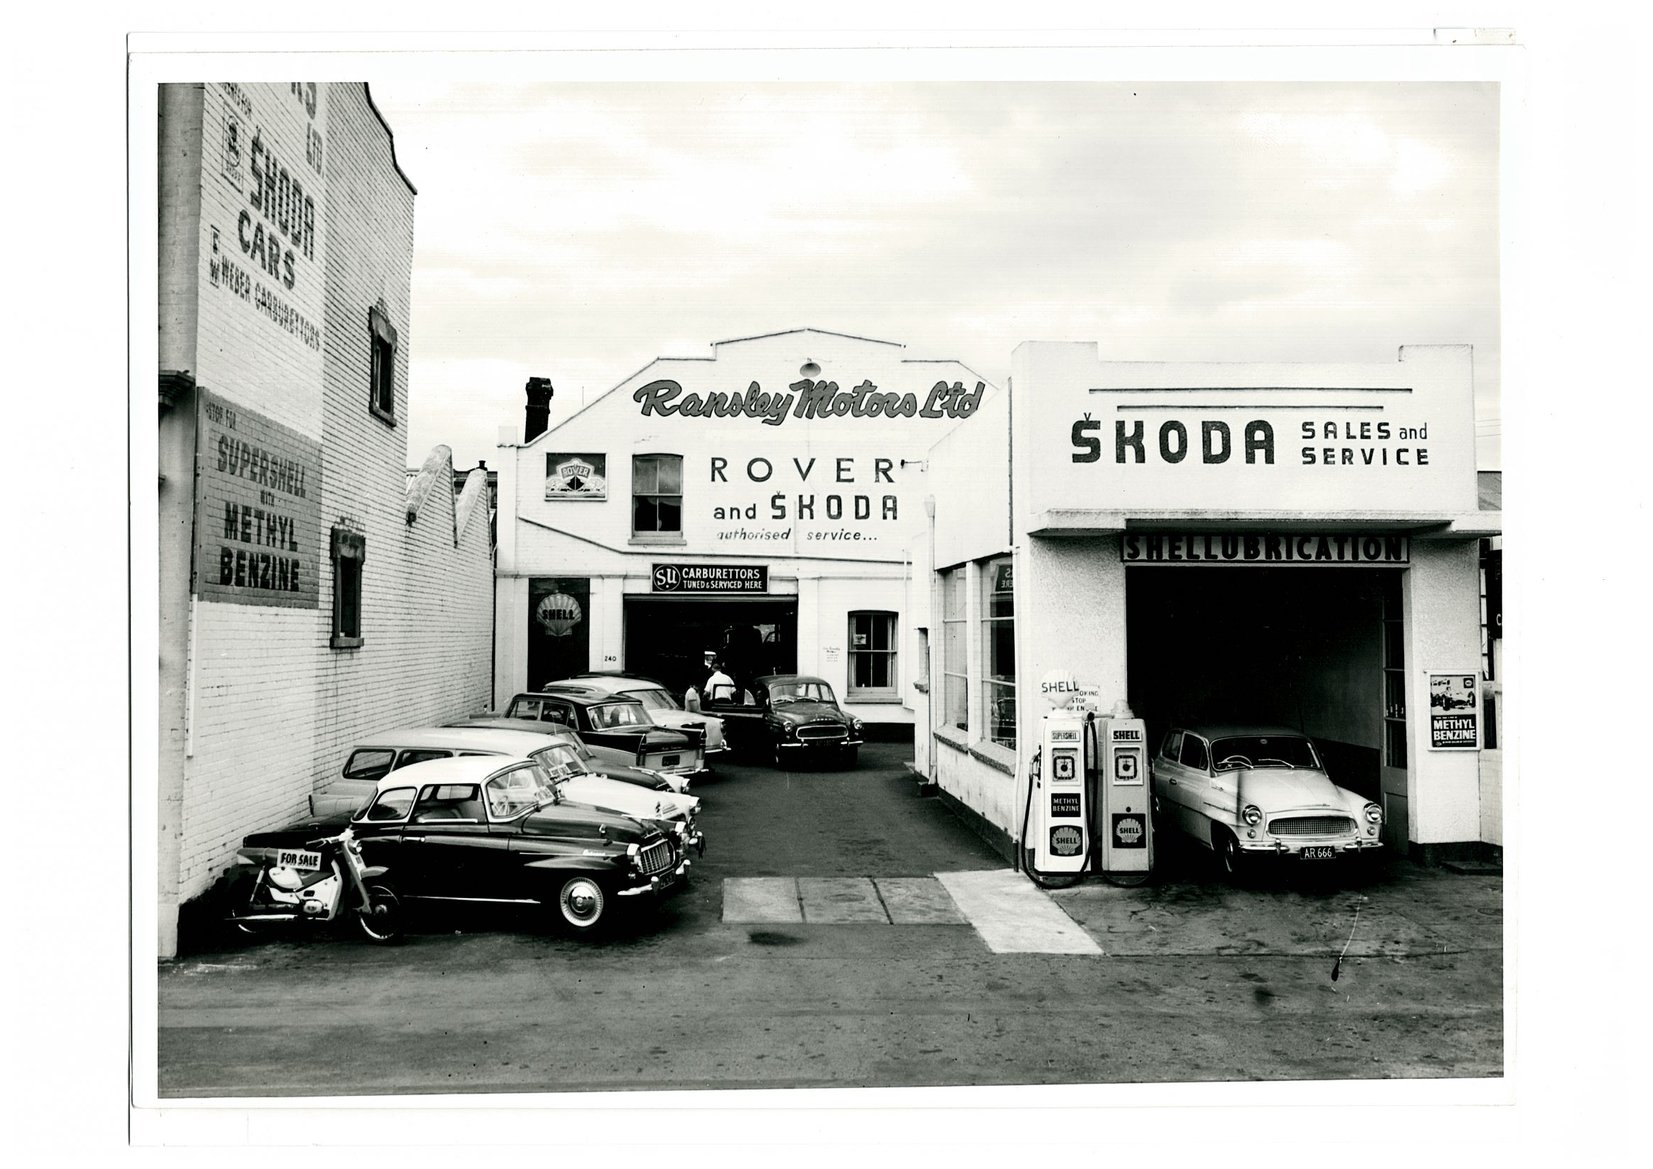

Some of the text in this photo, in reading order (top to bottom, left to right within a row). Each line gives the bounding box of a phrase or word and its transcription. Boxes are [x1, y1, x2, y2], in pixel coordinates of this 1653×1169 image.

[250, 124, 315, 262] ŠKODA
[238, 209, 295, 290] CARS
[221, 255, 320, 351] WEBER CARBURETTORS
[633, 378, 986, 426] Ransley Motors Ltd
[1071, 412, 1428, 465] ŠKODA SALES and
[1302, 447, 1429, 465] SERVICE
[218, 433, 306, 499] SUPERSHELL
[562, 465, 590, 478] ROVER
[710, 457, 895, 483] ROVER
[713, 491, 898, 520] and ŠKODA
[224, 501, 298, 552] METHYL
[1126, 535, 1402, 560] SHELLUBRICATION
[220, 547, 300, 592] BENZINE
[682, 568, 760, 579] CARBURETTORS
[683, 580, 705, 589] TUNED
[710, 580, 742, 589] SERVICED
[745, 581, 763, 589] HERE
[542, 608, 575, 620] SHELL
[1041, 680, 1079, 693] SHELL
[1433, 719, 1475, 730] METHYL
[1113, 730, 1140, 739] SHELL
[1433, 730, 1476, 741] BENZINE
[1055, 837, 1077, 845] SHELL
[280, 852, 319, 867] FOR SALE
[1304, 848, 1332, 858] AR 666
